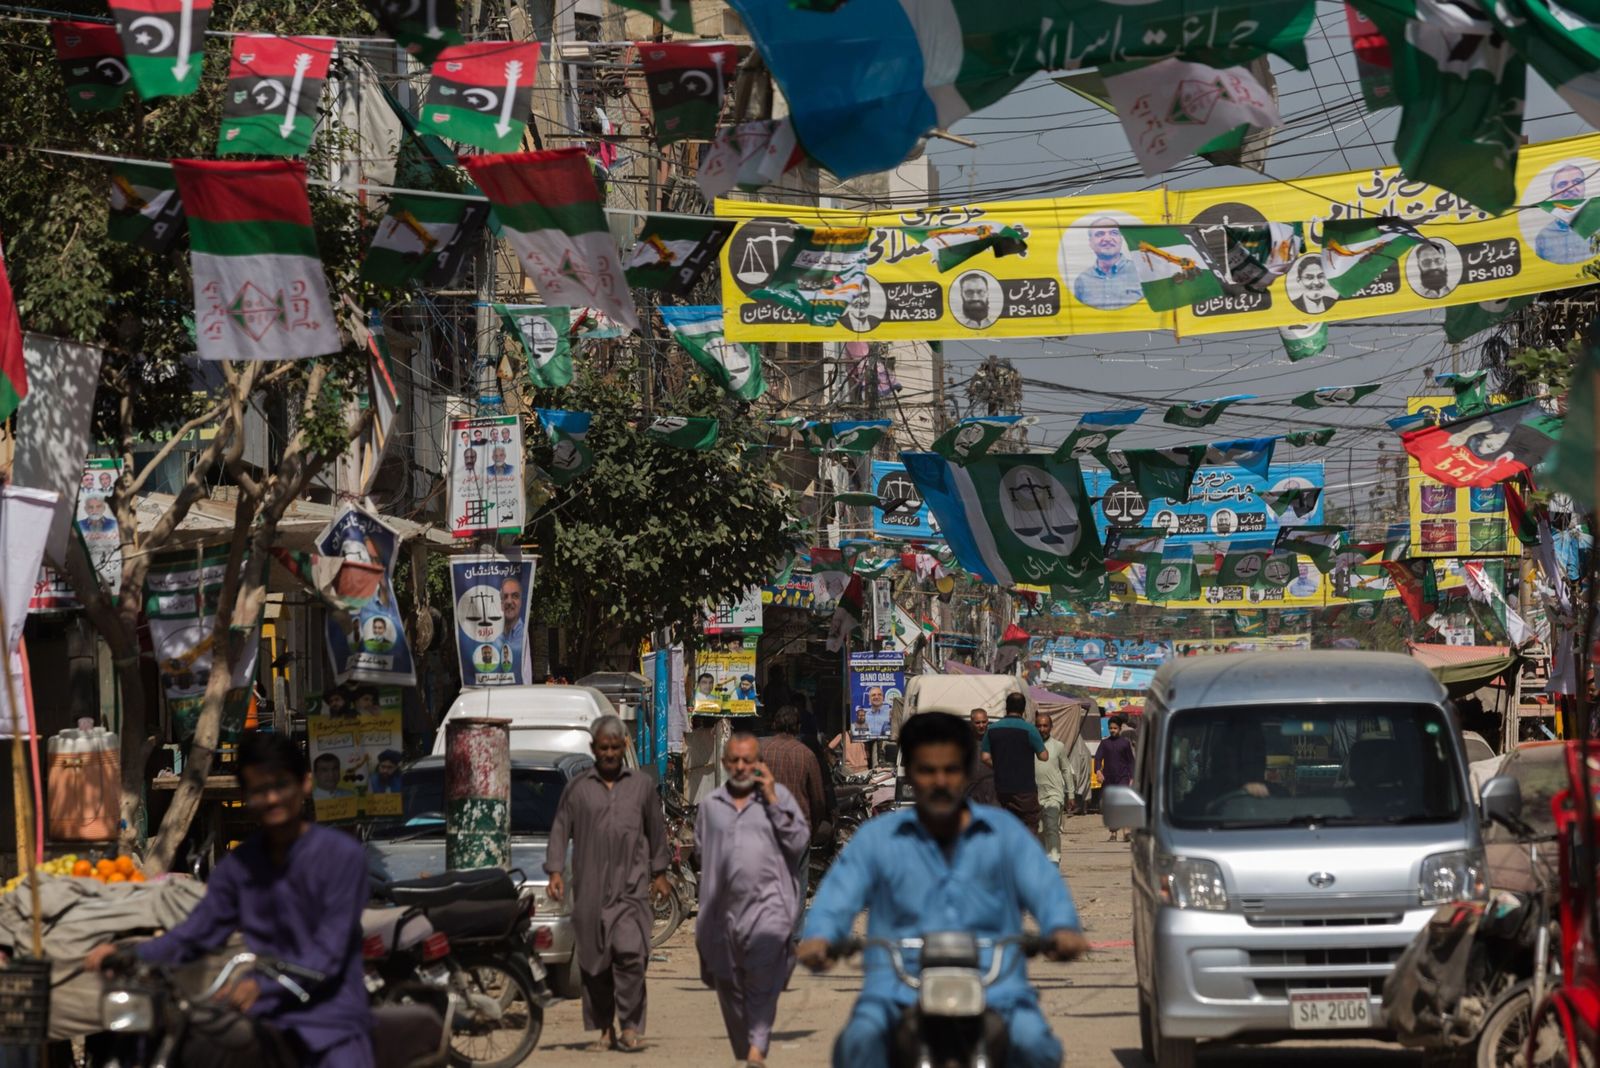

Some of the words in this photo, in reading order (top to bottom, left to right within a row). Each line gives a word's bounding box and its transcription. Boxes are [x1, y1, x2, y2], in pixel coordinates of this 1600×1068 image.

[1468, 264, 1514, 281] PS-103
[1350, 281, 1394, 298] A-238
[890, 308, 937, 320] NA-238
[1009, 303, 1053, 316] PS-103
[860, 673, 877, 682] BANO
